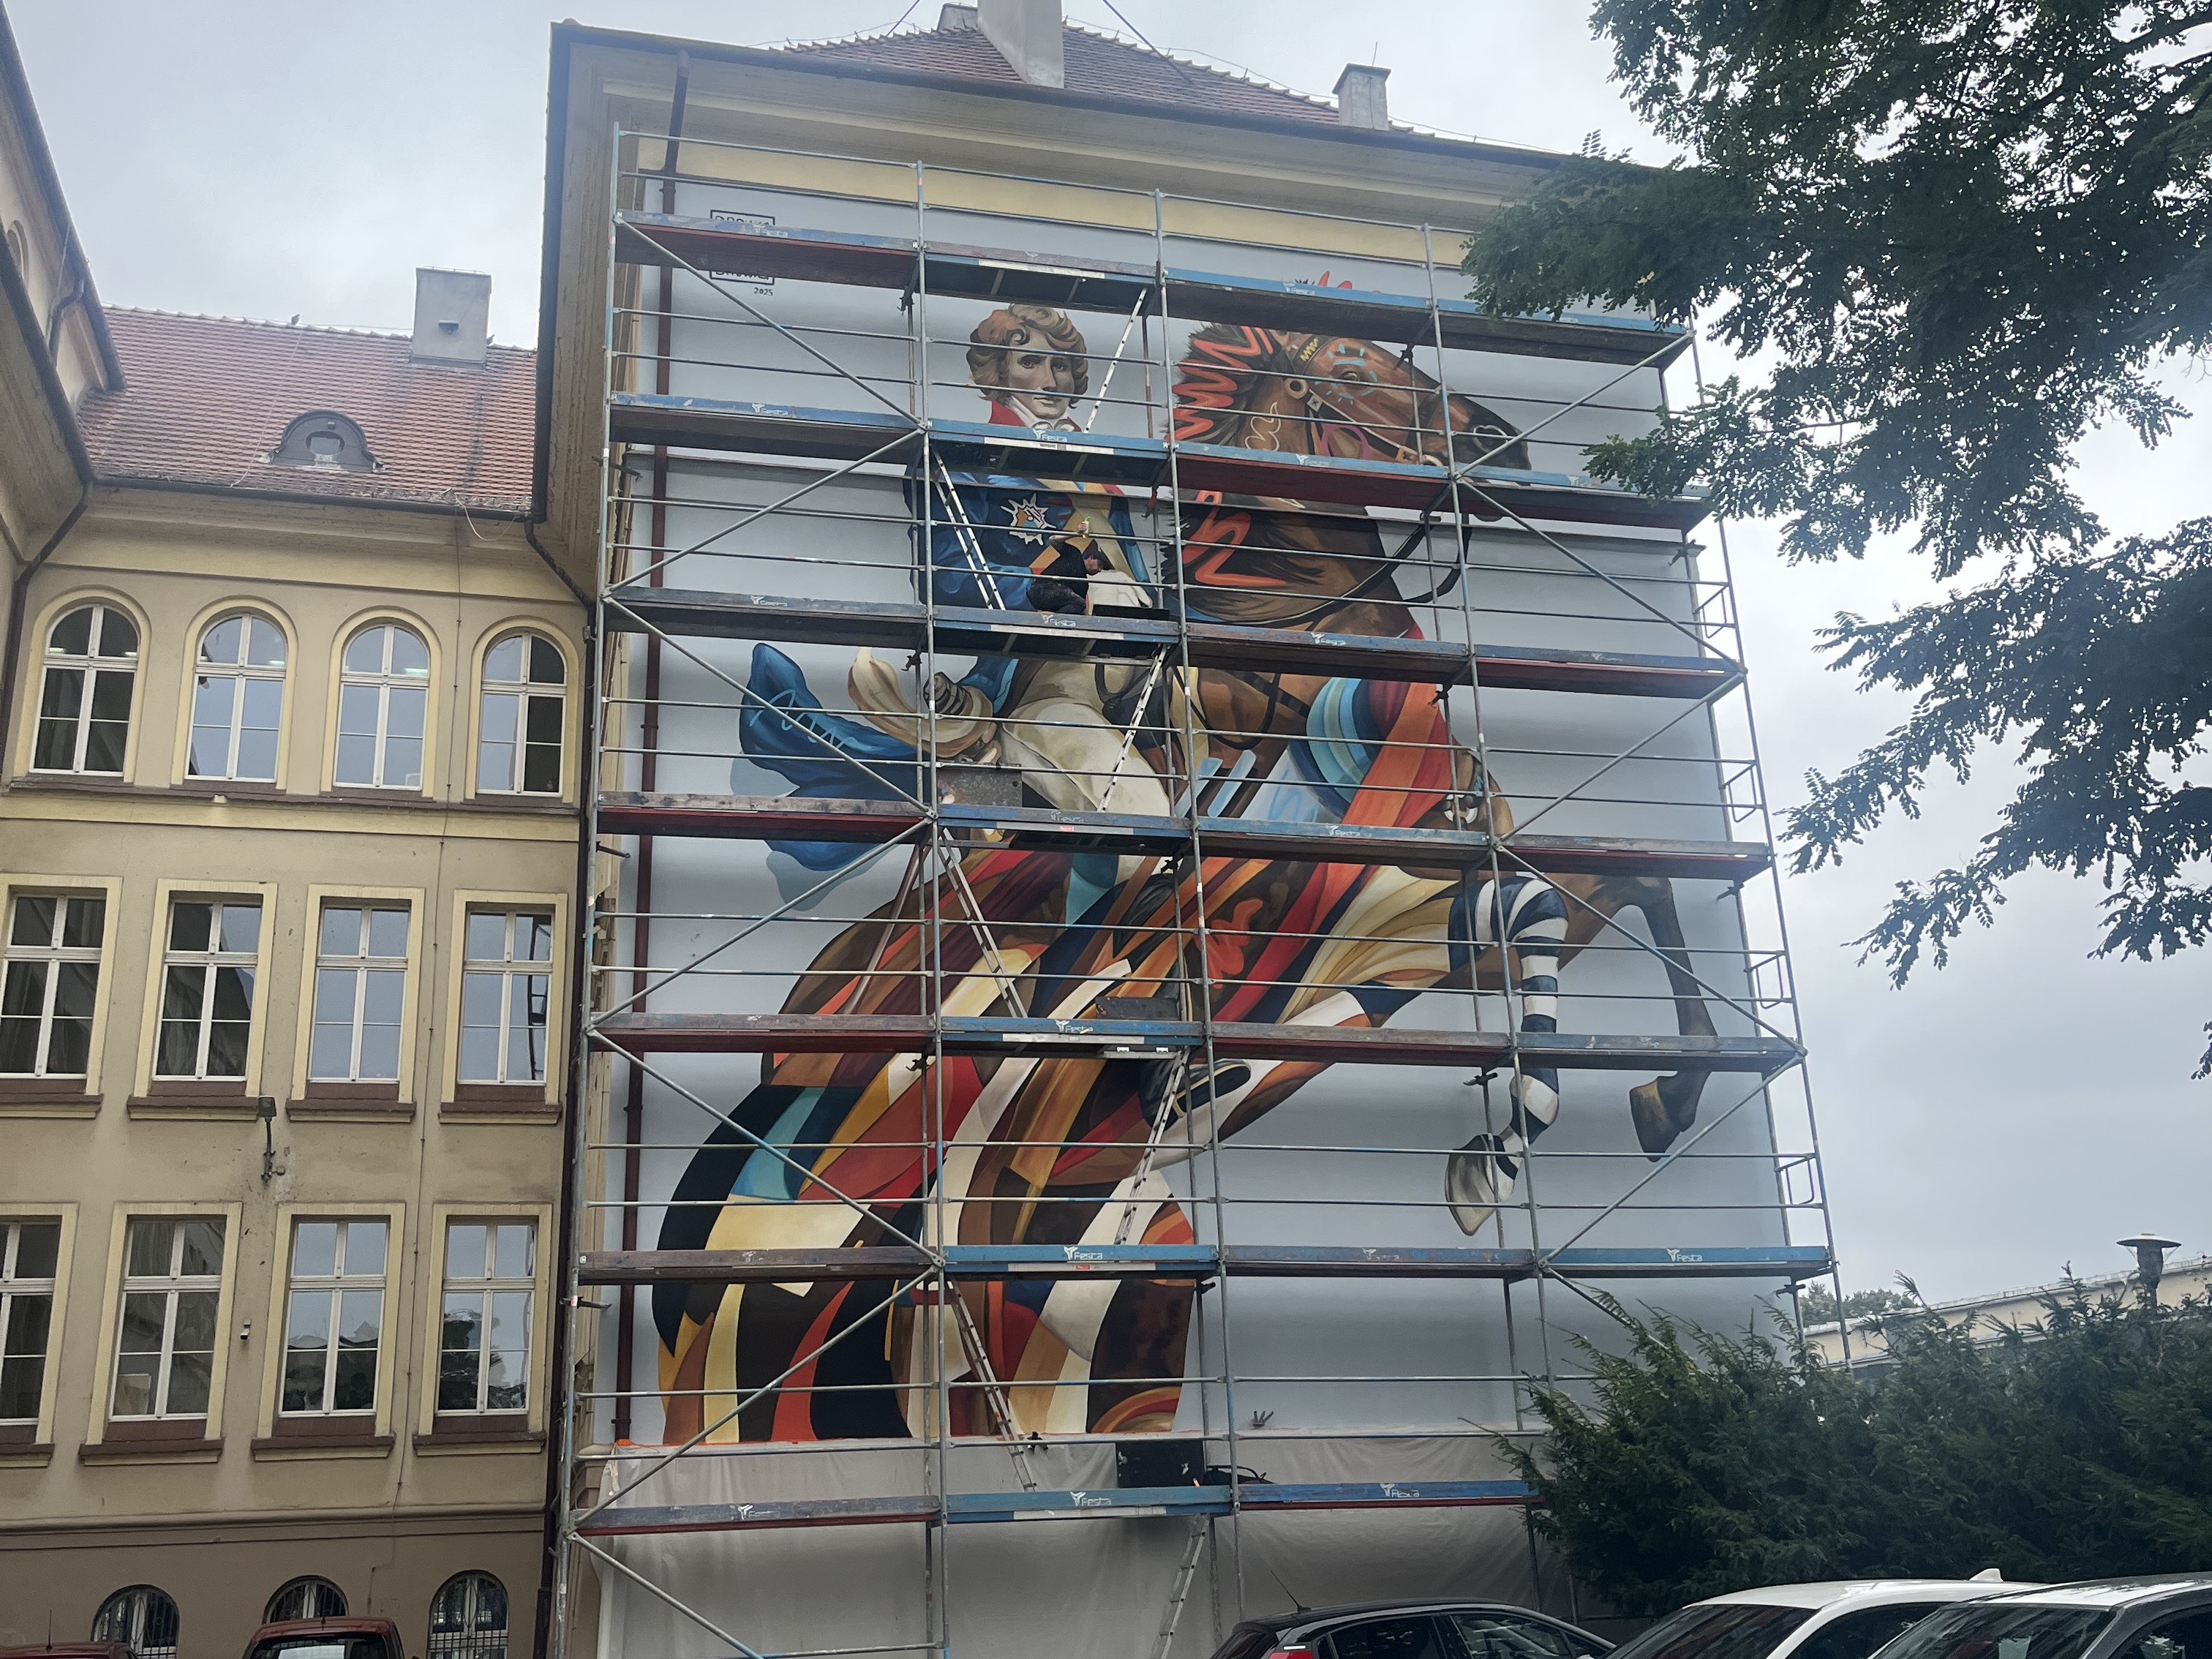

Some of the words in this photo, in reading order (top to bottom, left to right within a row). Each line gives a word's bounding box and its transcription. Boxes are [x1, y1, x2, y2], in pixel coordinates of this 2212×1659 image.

[754, 287, 773, 296] 2025
[1677, 1254, 1703, 1262] Festa
[1081, 1497, 1112, 1506] Festa
